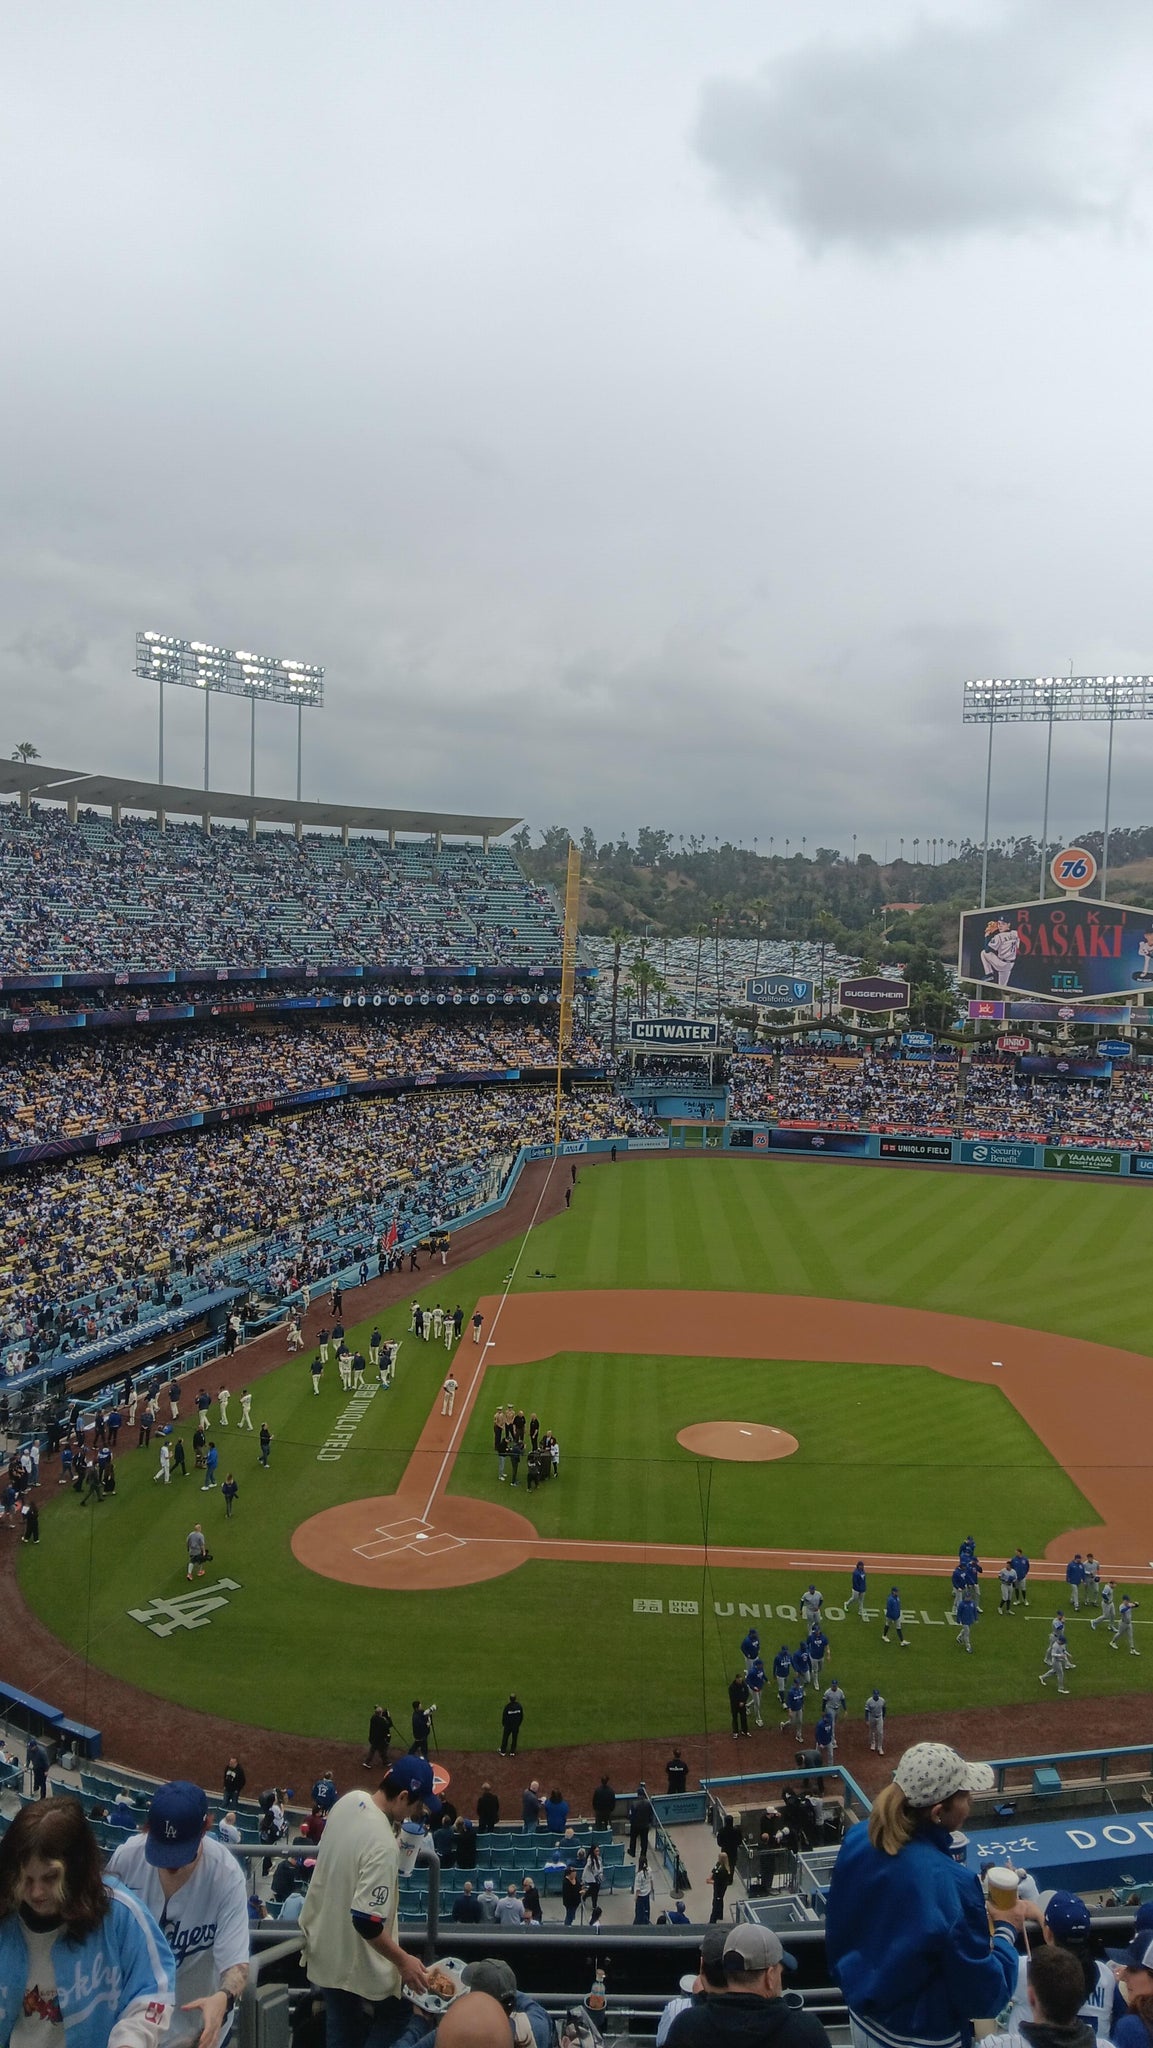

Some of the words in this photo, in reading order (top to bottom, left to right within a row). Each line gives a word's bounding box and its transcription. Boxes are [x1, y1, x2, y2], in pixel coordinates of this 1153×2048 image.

[1059, 857, 1088, 880] 76
[1017, 910, 1127, 924] ROKI
[1016, 924, 1124, 957] SASAKI
[752, 981, 789, 995] blue
[844, 990, 904, 999] GUGGENHEIM
[758, 995, 793, 1003] california
[636, 1024, 710, 1039] CUTWATER
[1003, 1037, 1025, 1048] JINRO
[755, 1135, 767, 1145] 76
[898, 1145, 925, 1154] UNIQLO
[927, 1147, 949, 1155] FIELD
[990, 1146, 1022, 1157] Security
[990, 1154, 1018, 1164] Benefit
[1140, 1161, 1153, 1169] UC
[335, 1400, 372, 1431] UNIQLO
[316, 1433, 353, 1461] FIELD
[858, 1603, 971, 1625] FEL
[318, 1788, 327, 1797] 12
[165, 1820, 177, 1839] LA
[976, 1837, 1039, 1857] ようこそ
